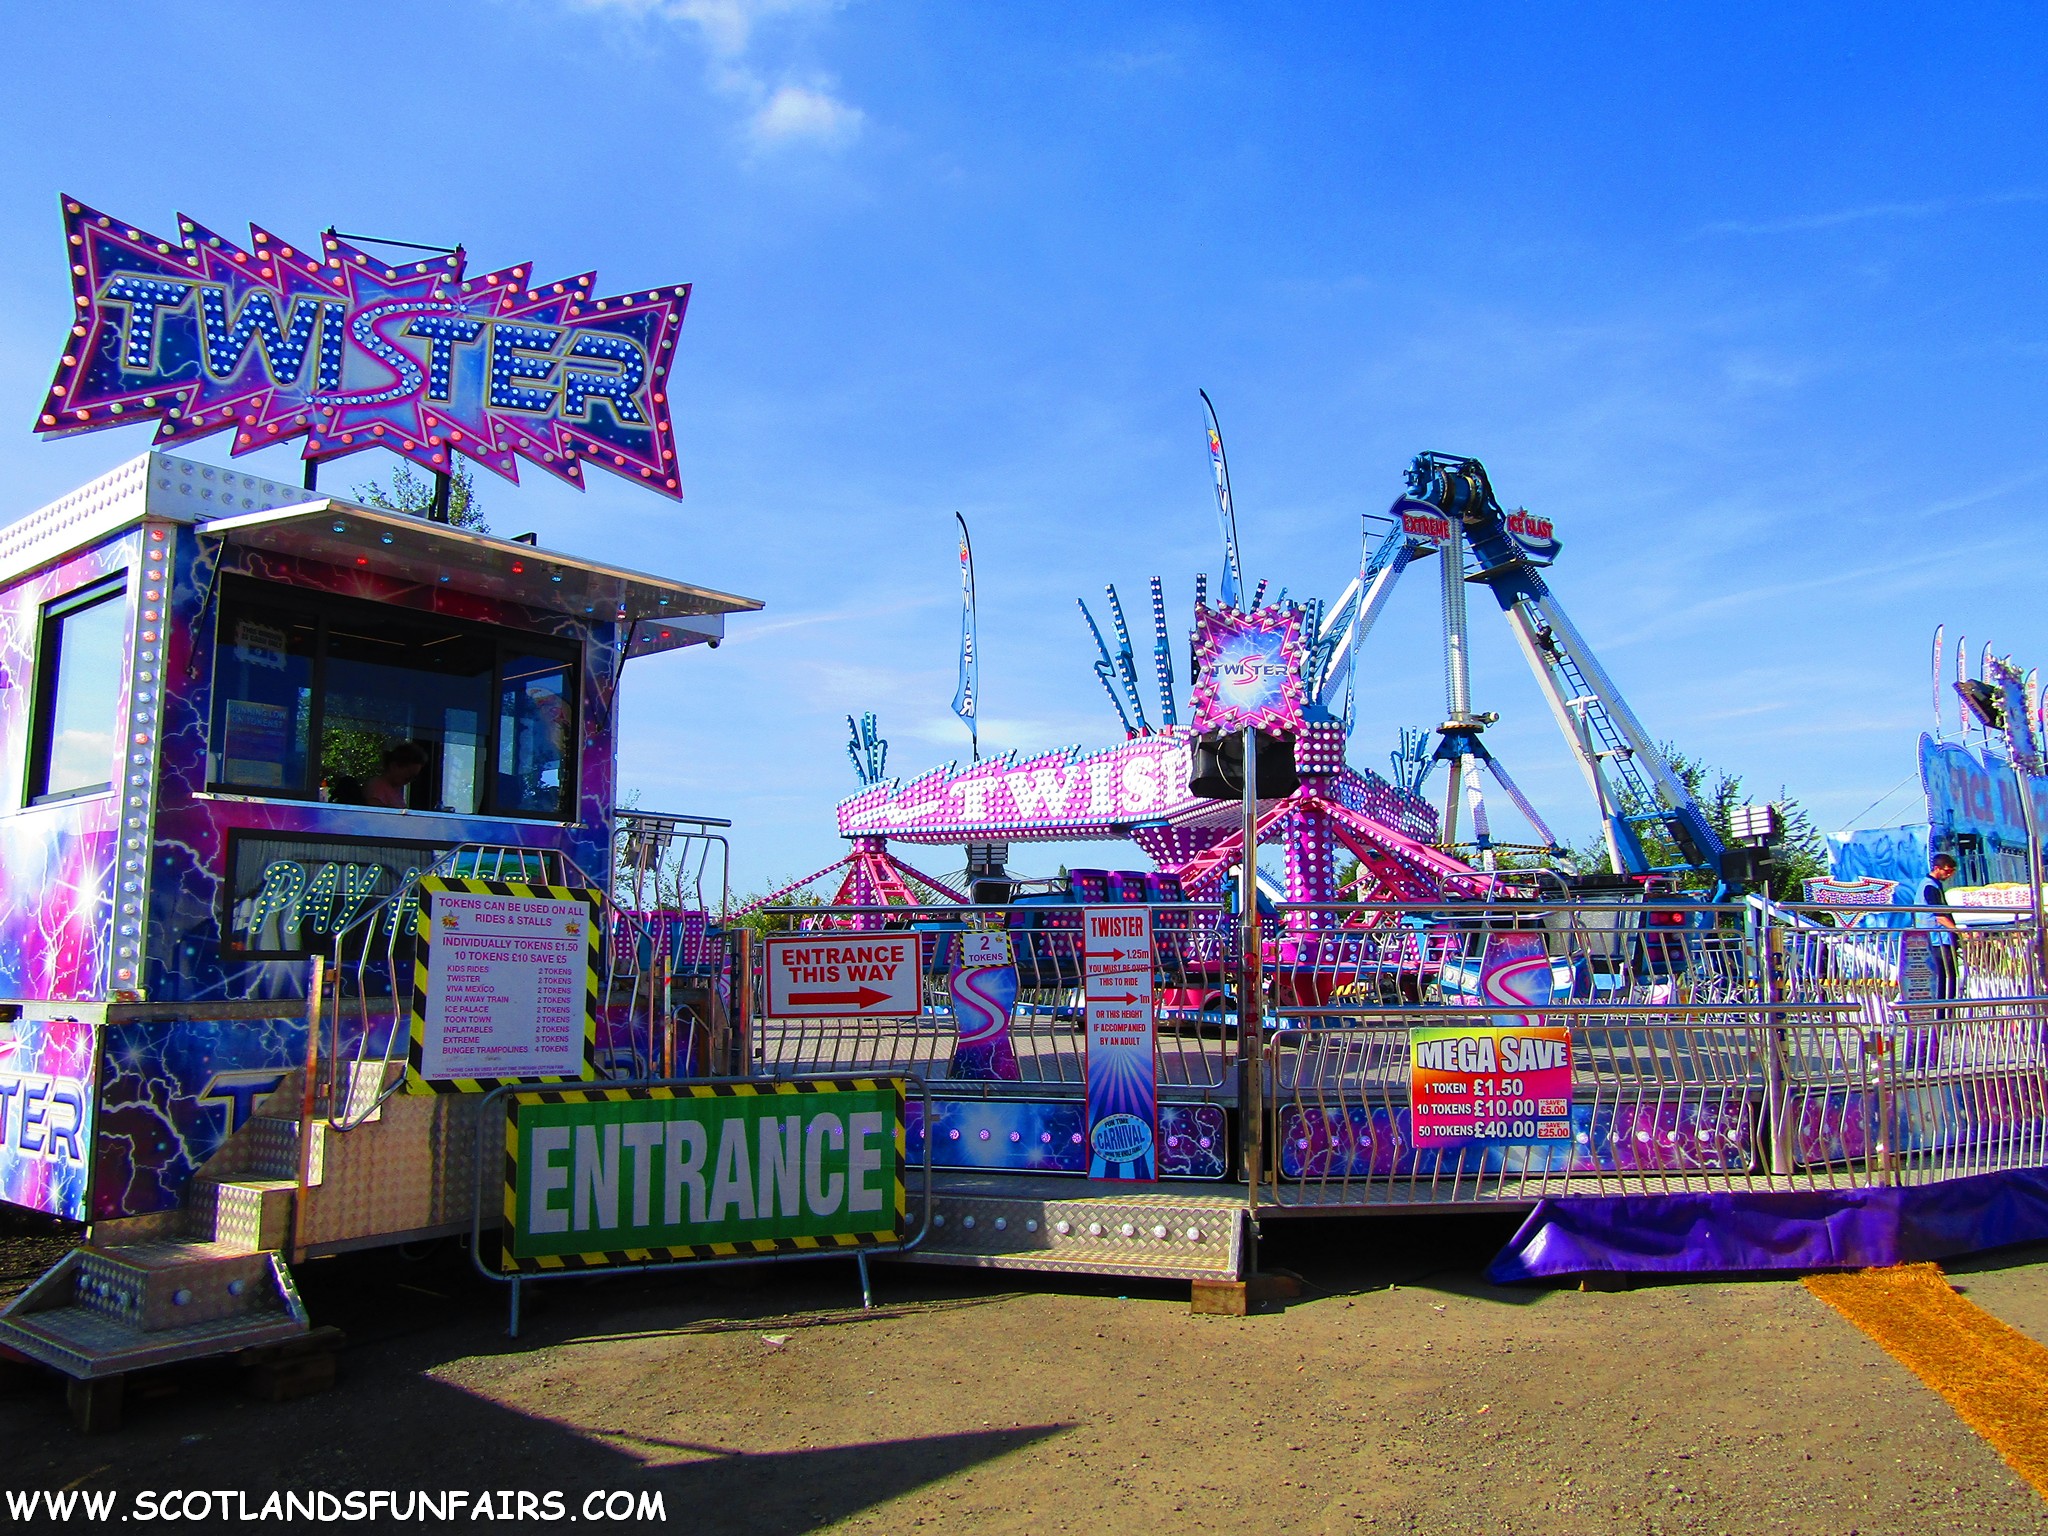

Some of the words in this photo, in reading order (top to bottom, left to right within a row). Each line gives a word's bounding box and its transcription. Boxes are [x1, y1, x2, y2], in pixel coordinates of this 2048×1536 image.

[97, 271, 651, 426] TWISTER
[1402, 514, 1450, 540] EXTREME
[1507, 514, 1525, 533] ICE
[1526, 519, 1553, 540] BLAST
[1211, 655, 1289, 686] TWISTER
[250, 860, 382, 934] PAY
[439, 898, 481, 909] TOKENS
[484, 902, 505, 912] CAN
[508, 902, 520, 912] BE
[524, 904, 549, 914] USED
[552, 906, 566, 915] ON
[568, 906, 584, 916] ALL
[475, 914, 505, 924] RIDES
[508, 916, 514, 924] &
[517, 916, 552, 926] STALLS
[1091, 916, 1143, 937] TWISTER
[443, 937, 512, 949] INDIVIDUALLY
[515, 942, 552, 950] TOKENS
[555, 943, 578, 952] £1.50
[980, 936, 990, 950] 2
[455, 952, 466, 960] 10
[469, 952, 509, 962] TOKENS
[512, 954, 528, 962] £10
[531, 955, 554, 963] SAVE
[782, 946, 904, 965] ENTRANCE
[969, 952, 1004, 962] TOKENS
[1126, 949, 1149, 959] 1.25m
[789, 966, 841, 983] THIS
[847, 964, 897, 982] WAY
[1089, 964, 1101, 973] YOU
[1102, 964, 1120, 973] MUST
[1123, 964, 1130, 972] BE
[1132, 964, 1149, 972] OVER
[1099, 978, 1113, 986] THIS
[1115, 978, 1122, 986] TO
[1124, 978, 1138, 986] RIDE
[1140, 994, 1150, 1004] 1m
[1096, 1010, 1105, 1018] OR
[1106, 1010, 1120, 1018] THIS
[1122, 1010, 1142, 1018] HEIGHT
[1094, 1024, 1099, 1032] IF
[1101, 1024, 1146, 1032] ACCOMPANIED
[1100, 1037, 1108, 1045] BY
[1111, 1037, 1119, 1045] AN
[1120, 1037, 1140, 1045] ADULT
[1417, 1037, 1497, 1073] MEGA
[1500, 1036, 1568, 1073] SAVE
[1424, 1083, 1429, 1093] 1
[1432, 1083, 1466, 1094] TOKEN
[1473, 1079, 1524, 1096] £1.50
[1417, 1104, 1428, 1114] 10
[1431, 1104, 1472, 1114] TOKENS
[1474, 1100, 1534, 1117] £10.00
[1541, 1106, 1565, 1114] £5.00
[1097, 1124, 1145, 1150] CARNIVAL
[1419, 1126, 1430, 1136] 50
[1432, 1125, 1474, 1136] TOKENS
[1474, 1120, 1534, 1138] £40.00
[1538, 1128, 1568, 1137] £25.00
[529, 1111, 883, 1234] ENTRANCE
